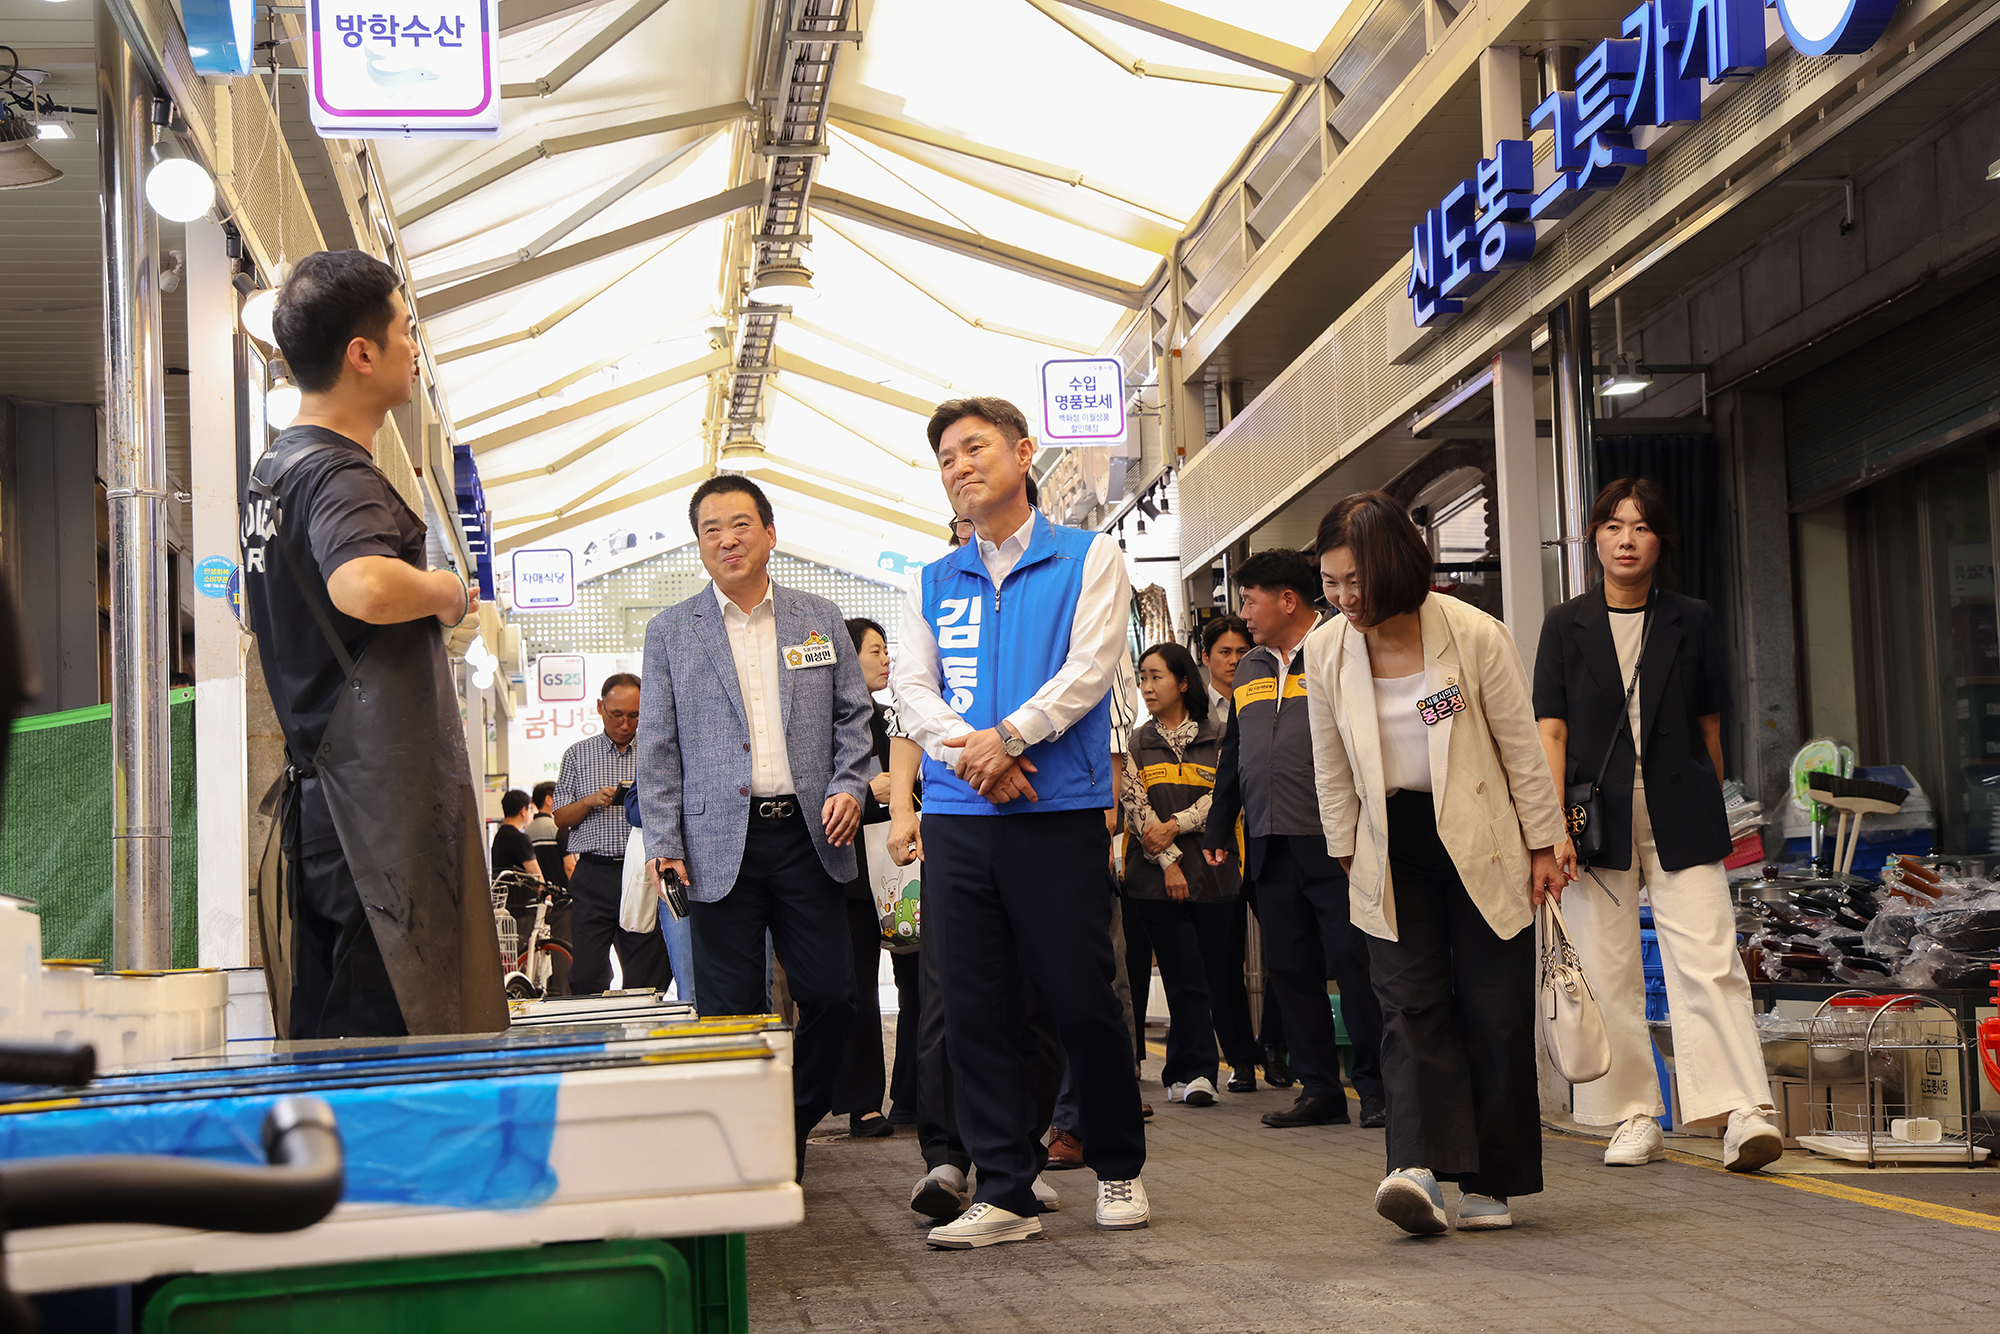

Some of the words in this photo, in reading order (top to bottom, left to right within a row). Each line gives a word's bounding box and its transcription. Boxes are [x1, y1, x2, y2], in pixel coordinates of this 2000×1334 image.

[335, 14, 466, 49] 방학수산
[1408, 139, 1512, 328] 신도봉
[1530, 0, 1733, 220] 그릇가게
[1069, 375, 1097, 391] 수입
[1054, 393, 1113, 411] 명품보세
[1058, 414, 1080, 423] 백화점
[1082, 412, 1110, 422] 이월상품
[521, 571, 565, 584] 자매식당
[804, 650, 831, 663] 이성민
[542, 672, 582, 686] GS25
[1421, 693, 1466, 725] 홍은정
[1920, 1077, 1948, 1095] 신도봉시장
